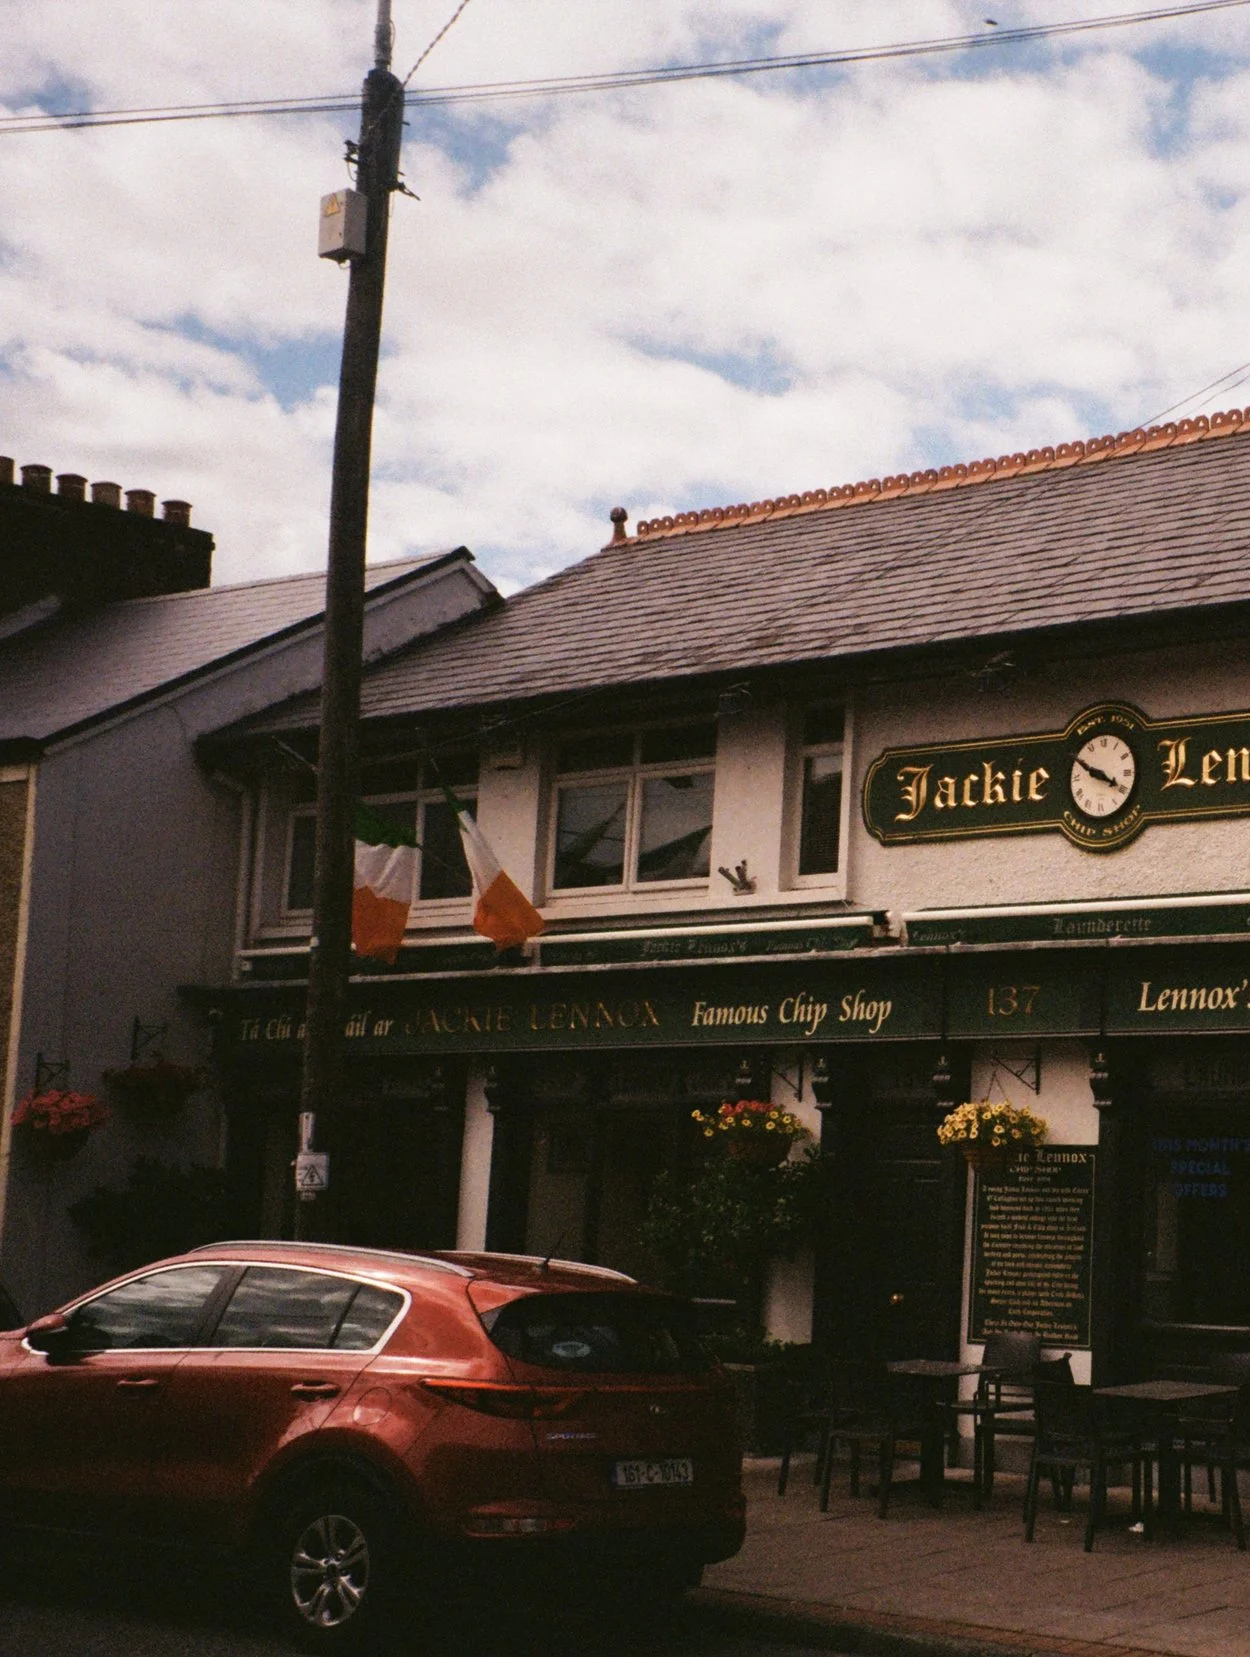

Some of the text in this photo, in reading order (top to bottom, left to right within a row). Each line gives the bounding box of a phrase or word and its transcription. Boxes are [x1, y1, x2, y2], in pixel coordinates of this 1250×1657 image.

[894, 757, 1051, 824] Jackie
[1063, 804, 1141, 837] CHIP SHOP
[691, 988, 892, 1035] Famous Chip Shop
[987, 985, 1040, 1017] 137
[344, 1010, 372, 1037] áil
[373, 1016, 395, 1037] ar
[404, 1000, 660, 1036] JACKIE LENNOX
[1034, 1149, 1087, 1163] Lennox
[1170, 1159, 1231, 1175] SPECIAL
